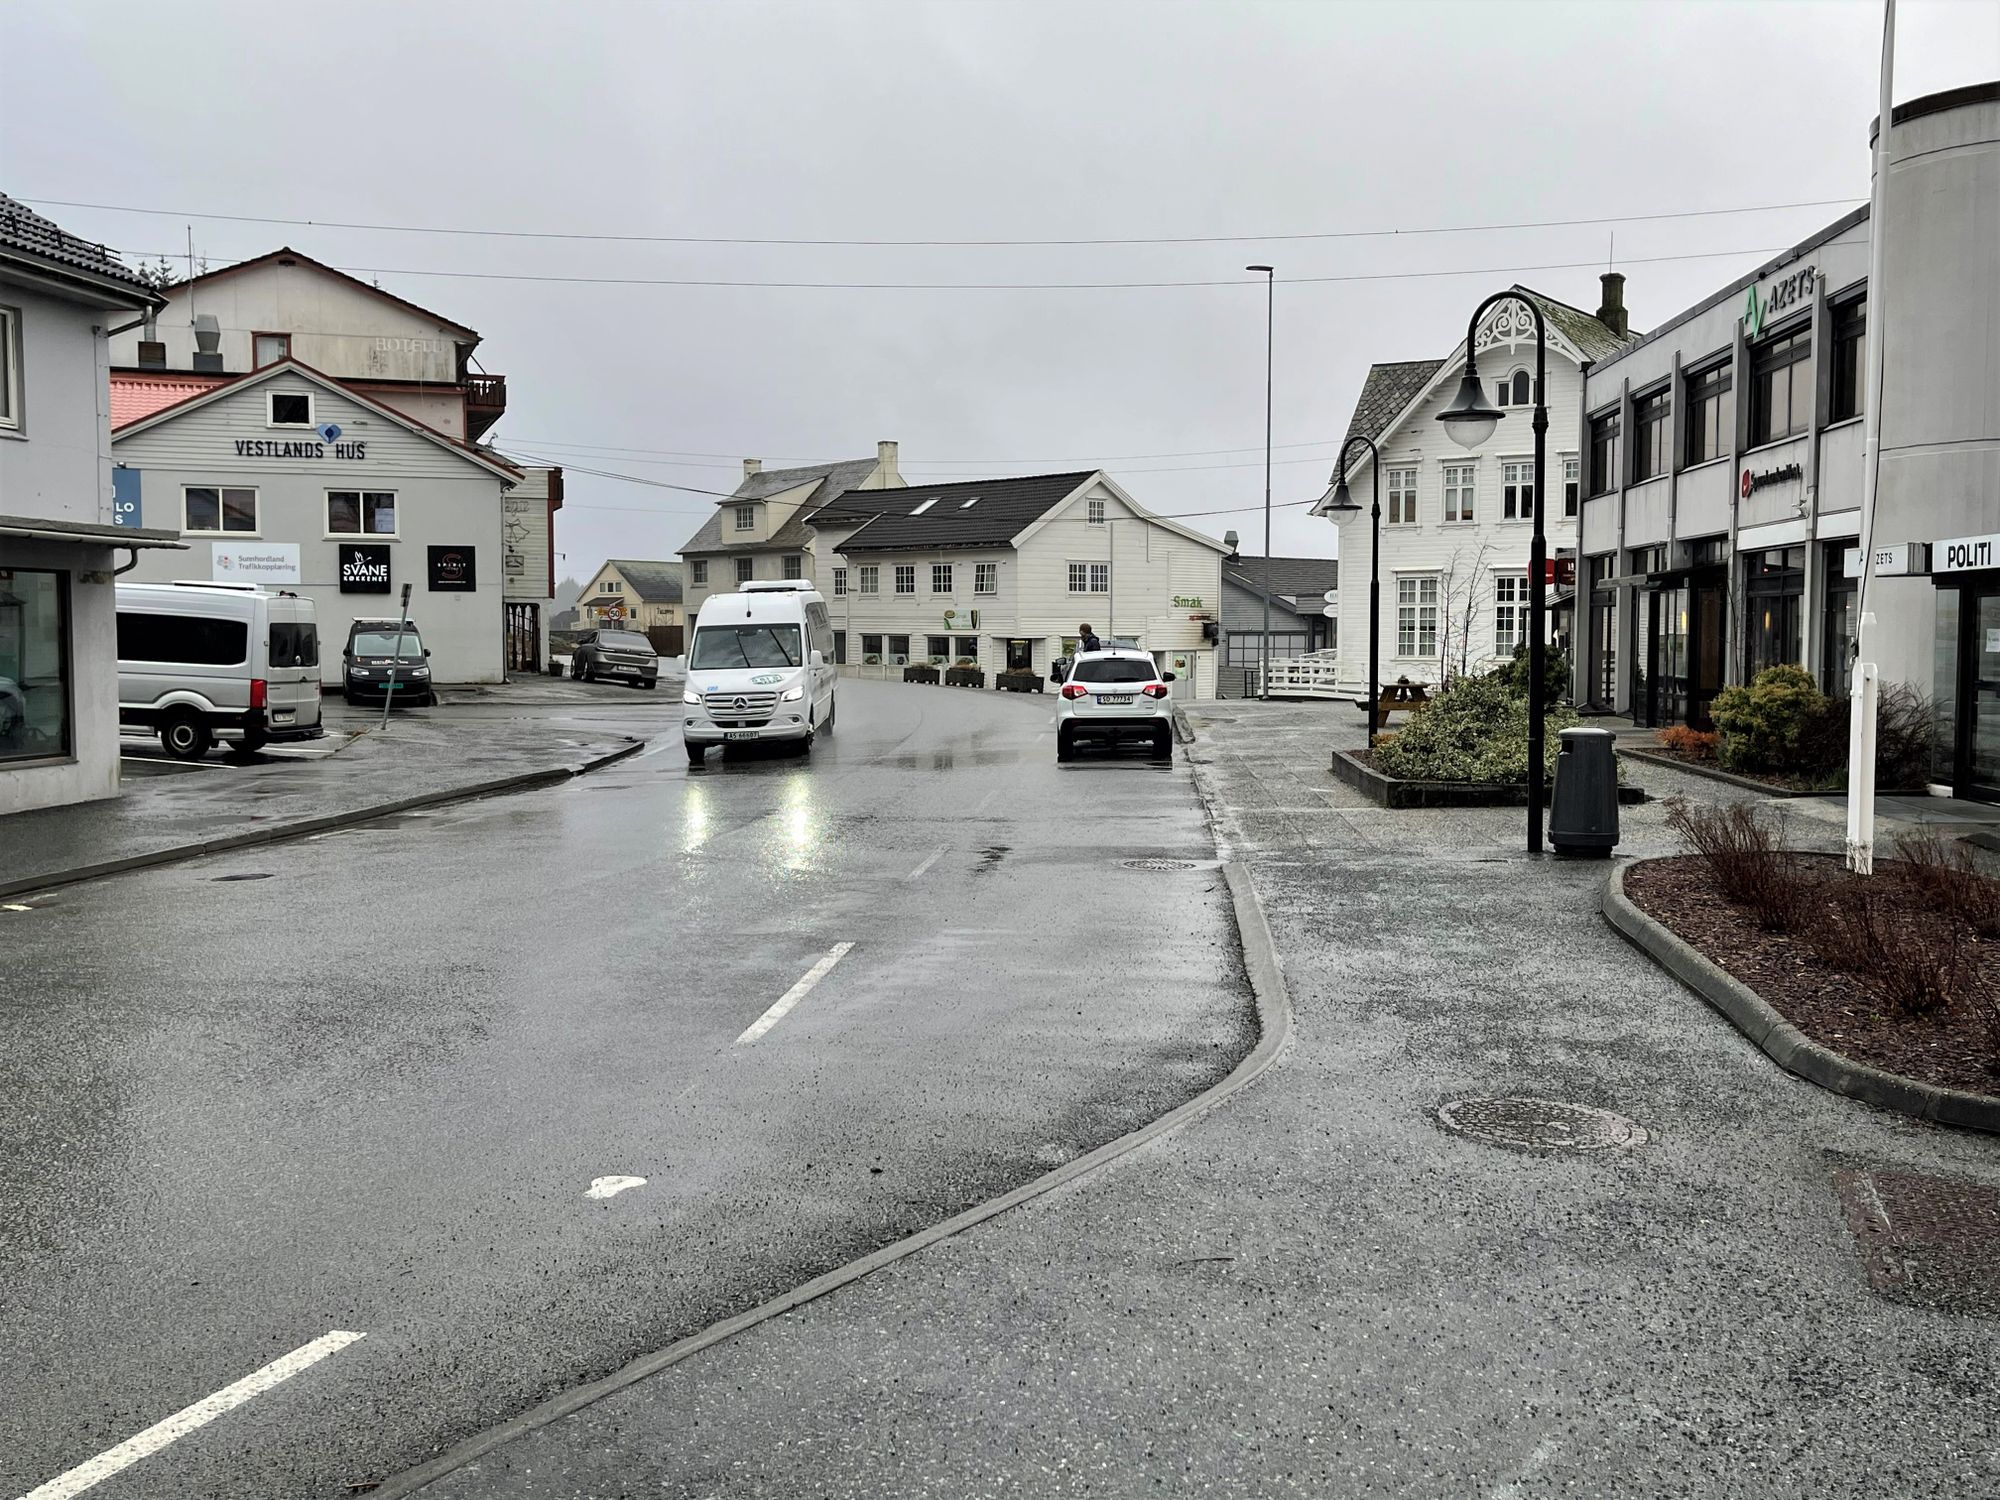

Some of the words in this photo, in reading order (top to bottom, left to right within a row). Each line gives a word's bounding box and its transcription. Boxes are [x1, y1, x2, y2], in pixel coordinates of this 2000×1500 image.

[1768, 265, 1815, 313] AZETS
[376, 337, 442, 352] HOTELL
[235, 440, 324, 458] VESTLANDS
[335, 442, 366, 459] HUS
[238, 555, 285, 563] Sunnhordland
[1875, 552, 1893, 565] ZETS
[1947, 541, 1992, 568] POLITI
[343, 563, 388, 576] SVANE
[1172, 595, 1203, 608] Smak
